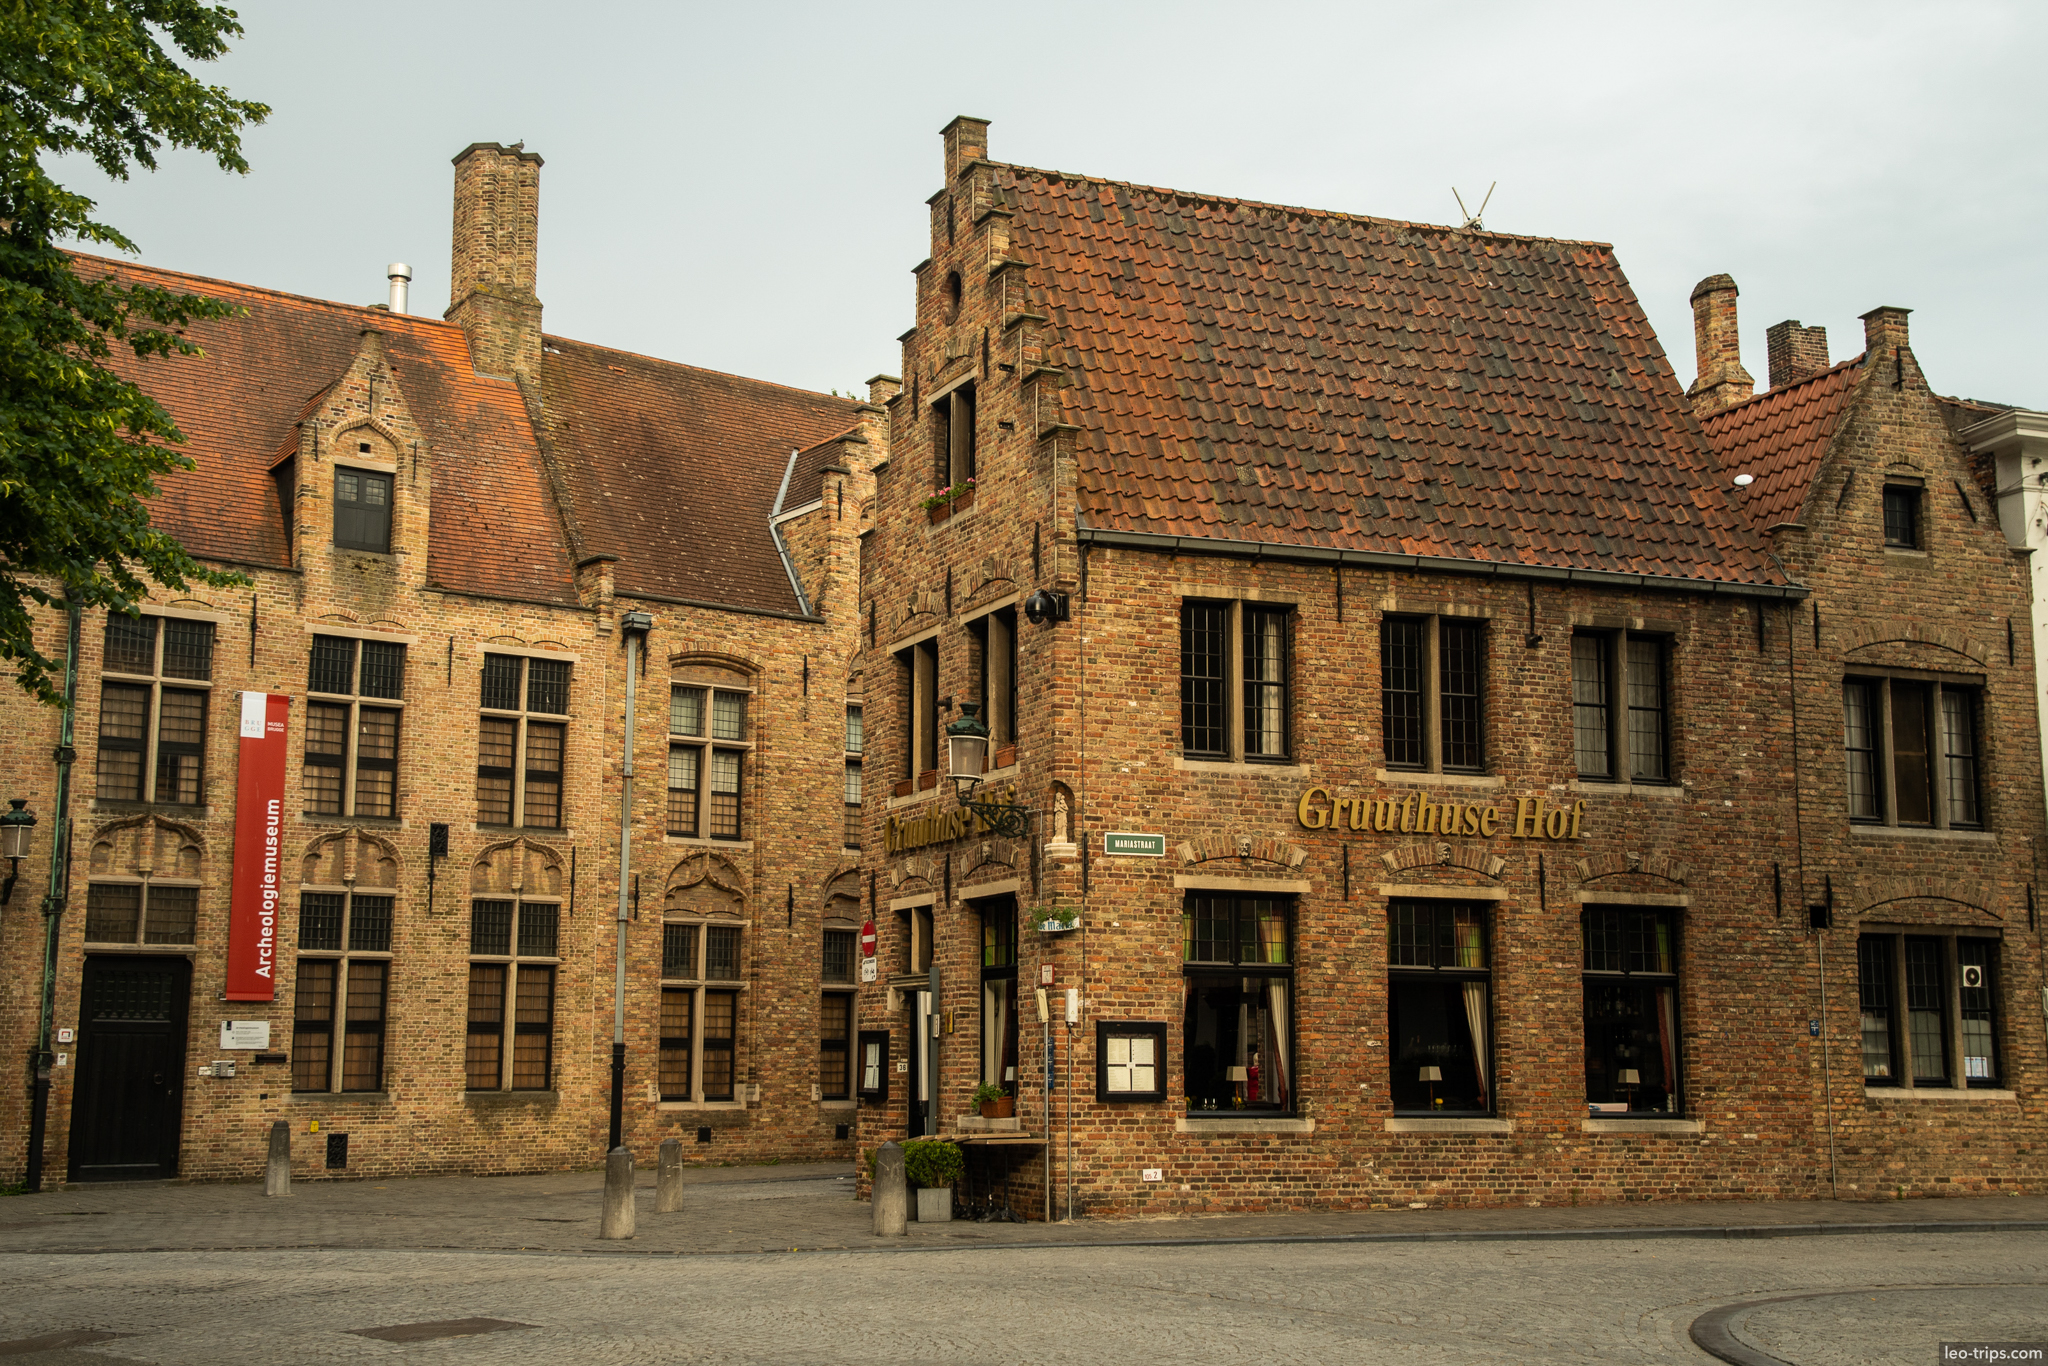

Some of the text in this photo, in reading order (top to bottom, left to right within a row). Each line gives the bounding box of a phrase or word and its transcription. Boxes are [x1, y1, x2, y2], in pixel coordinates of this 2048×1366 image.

[884, 804, 971, 853] Gruuthuse
[1299, 787, 1586, 839] Gruuthuse Hof
[1115, 840, 1155, 849] MARIASTRAAT
[255, 799, 280, 978] Archeologiemuseum
